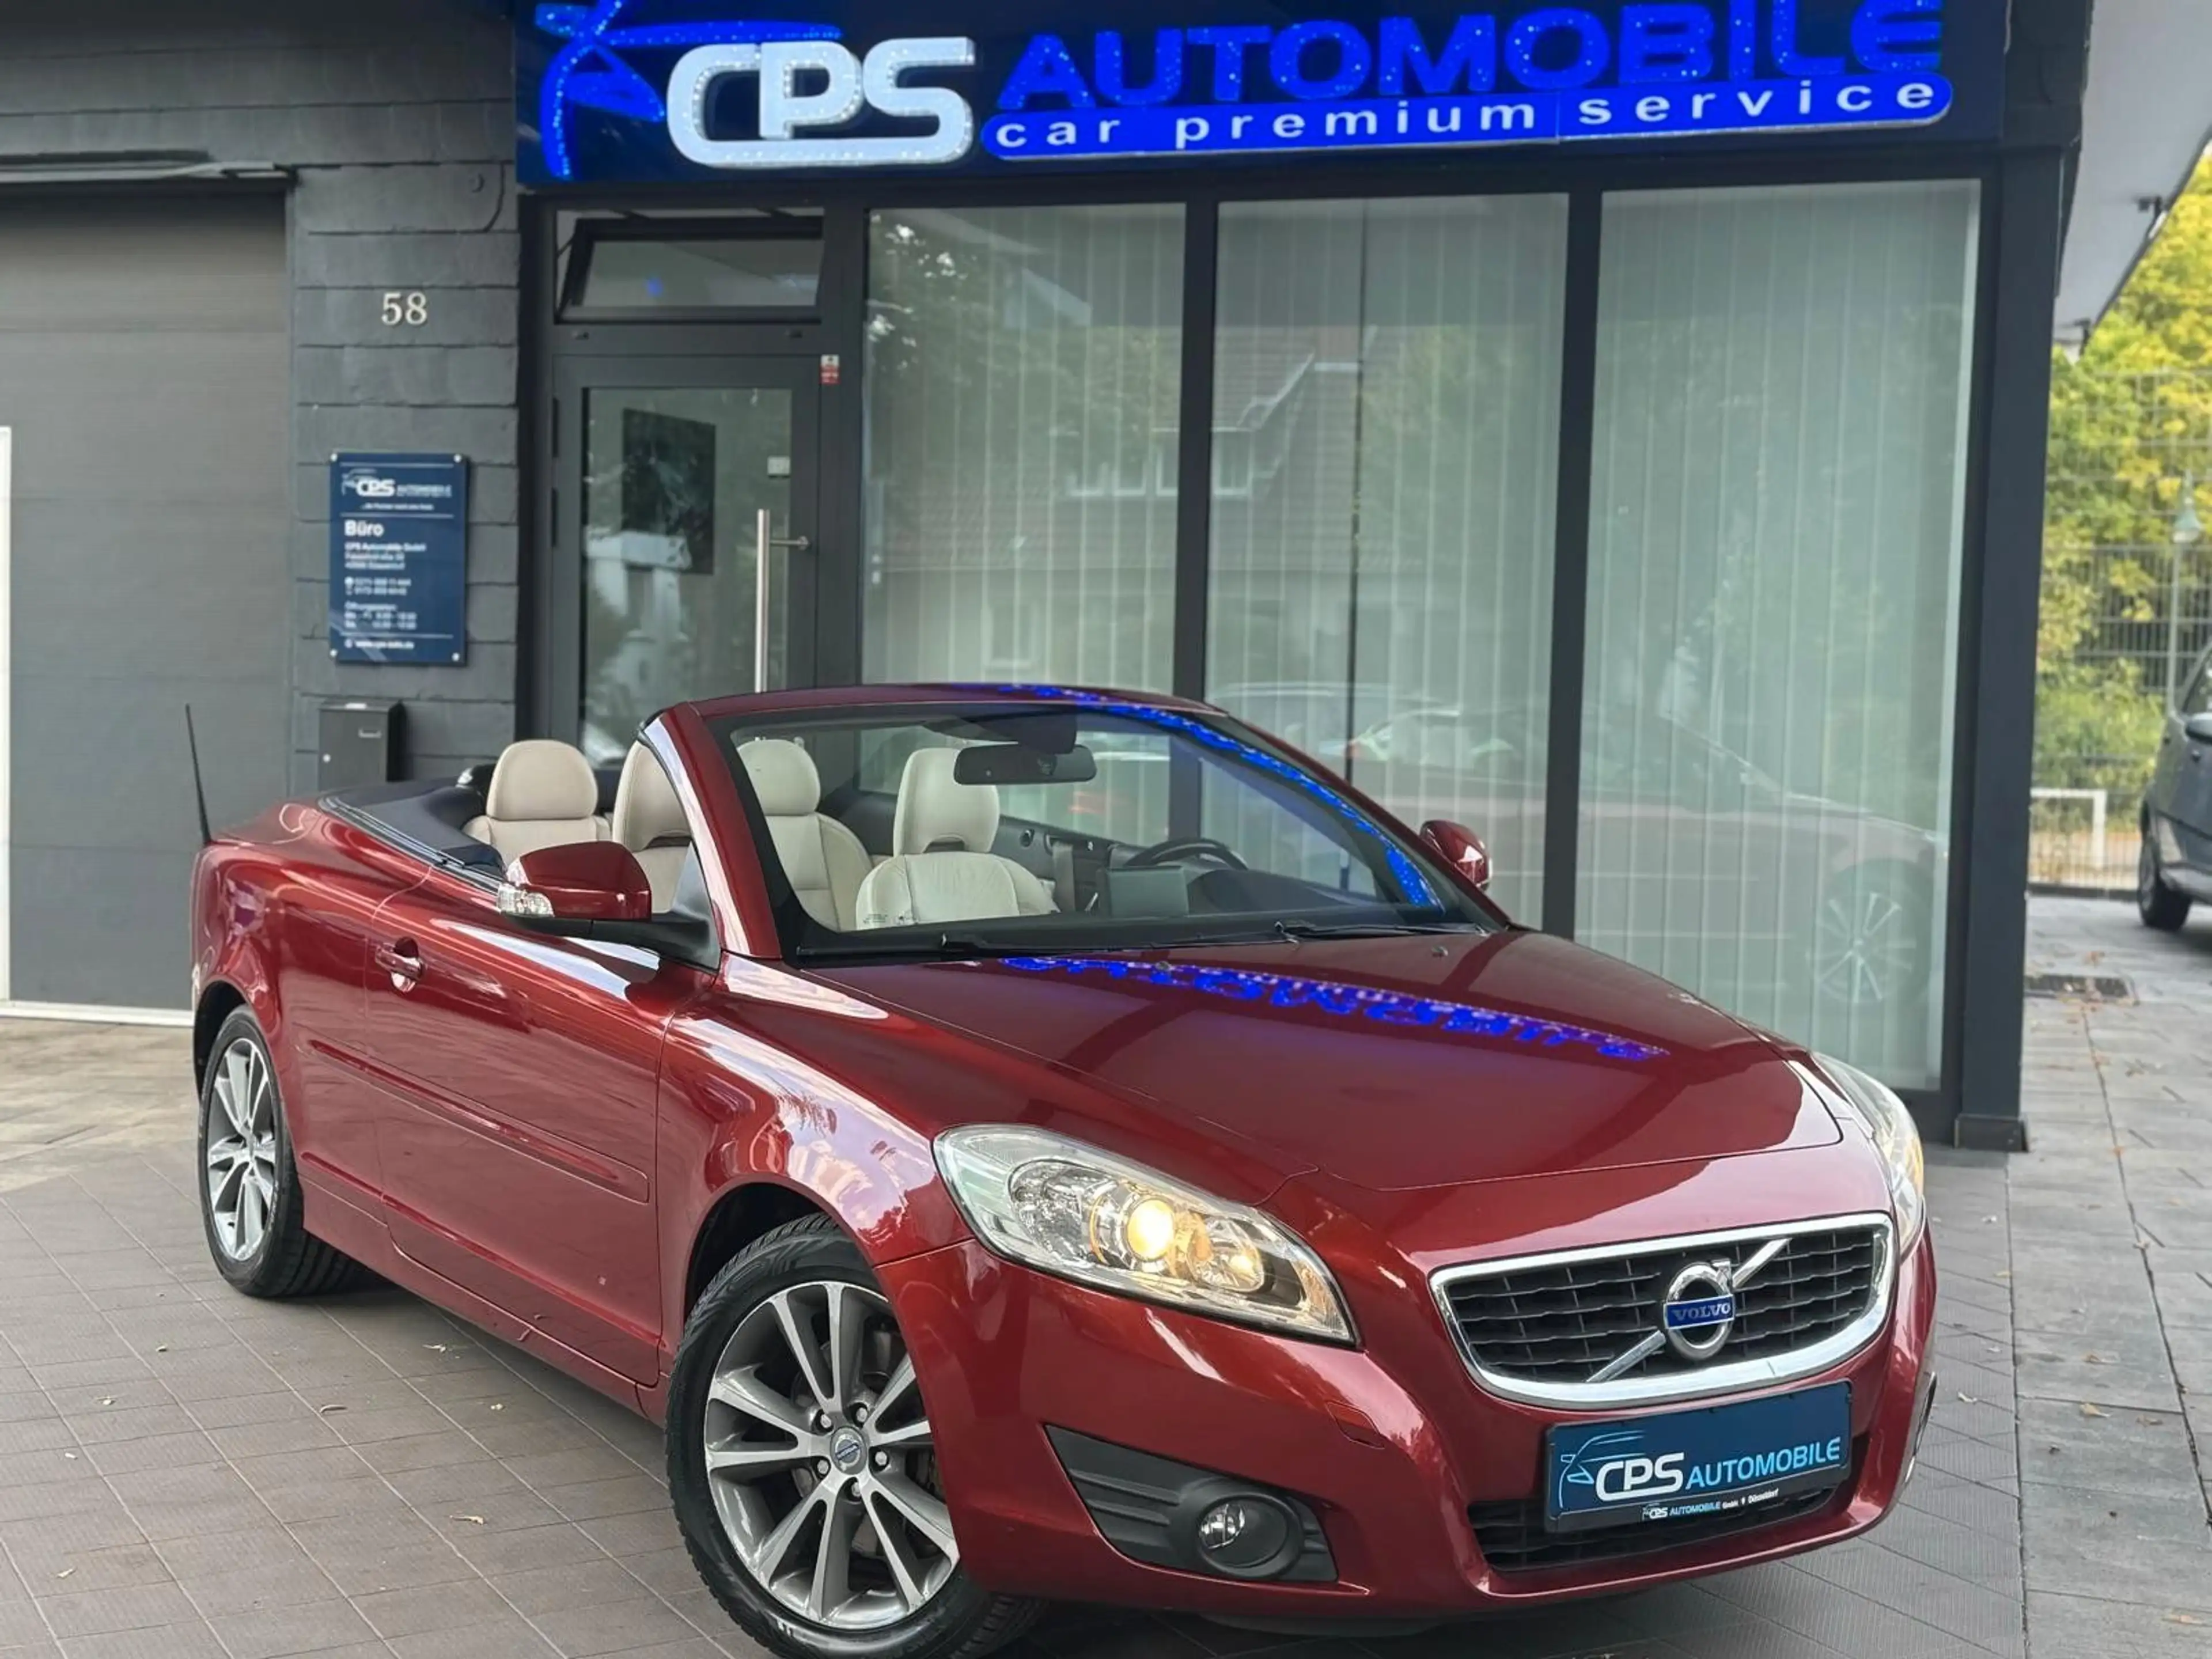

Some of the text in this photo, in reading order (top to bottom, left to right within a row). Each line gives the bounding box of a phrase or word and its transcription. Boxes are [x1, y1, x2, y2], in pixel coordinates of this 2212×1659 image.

[667, 0, 1944, 167] CPS AUTOMOBILE
[996, 80, 1934, 150] car premium service
[381, 291, 427, 325] 58
[355, 478, 395, 497] CPS
[344, 520, 384, 537] Büro
[1672, 1302, 1731, 1321] VOLVO
[1595, 1436, 1840, 1502] CPS AUTOMOBILE
[1649, 1506, 1668, 1519] CPS
[1669, 1501, 1721, 1516] AUTOMOBILE
